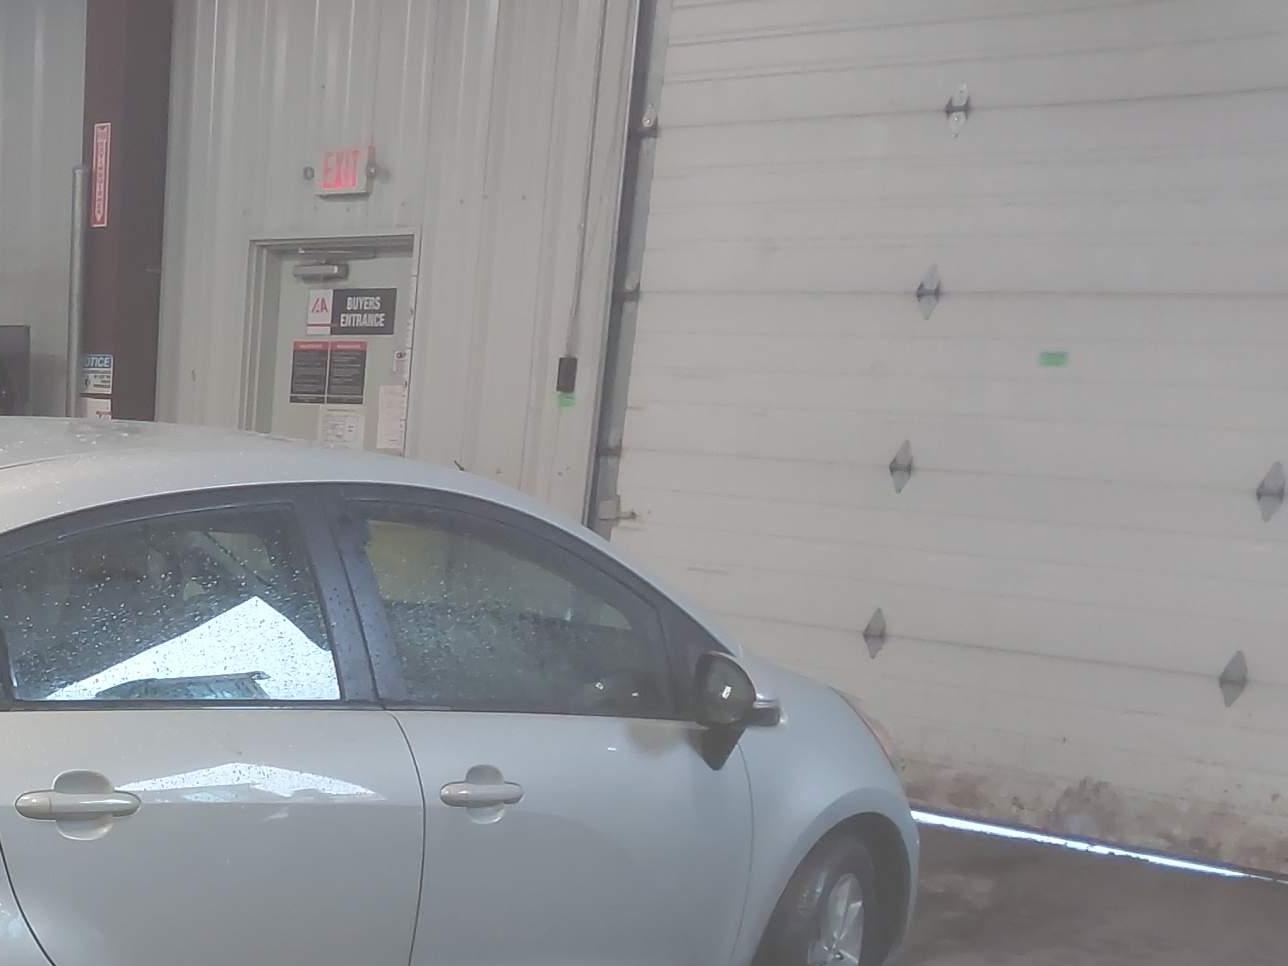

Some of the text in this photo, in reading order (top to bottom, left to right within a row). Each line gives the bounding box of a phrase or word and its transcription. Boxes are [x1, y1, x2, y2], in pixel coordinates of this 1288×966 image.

[323, 151, 360, 188] EXIT
[346, 296, 381, 311] BUYERS
[340, 312, 386, 328] ENTRANCE
